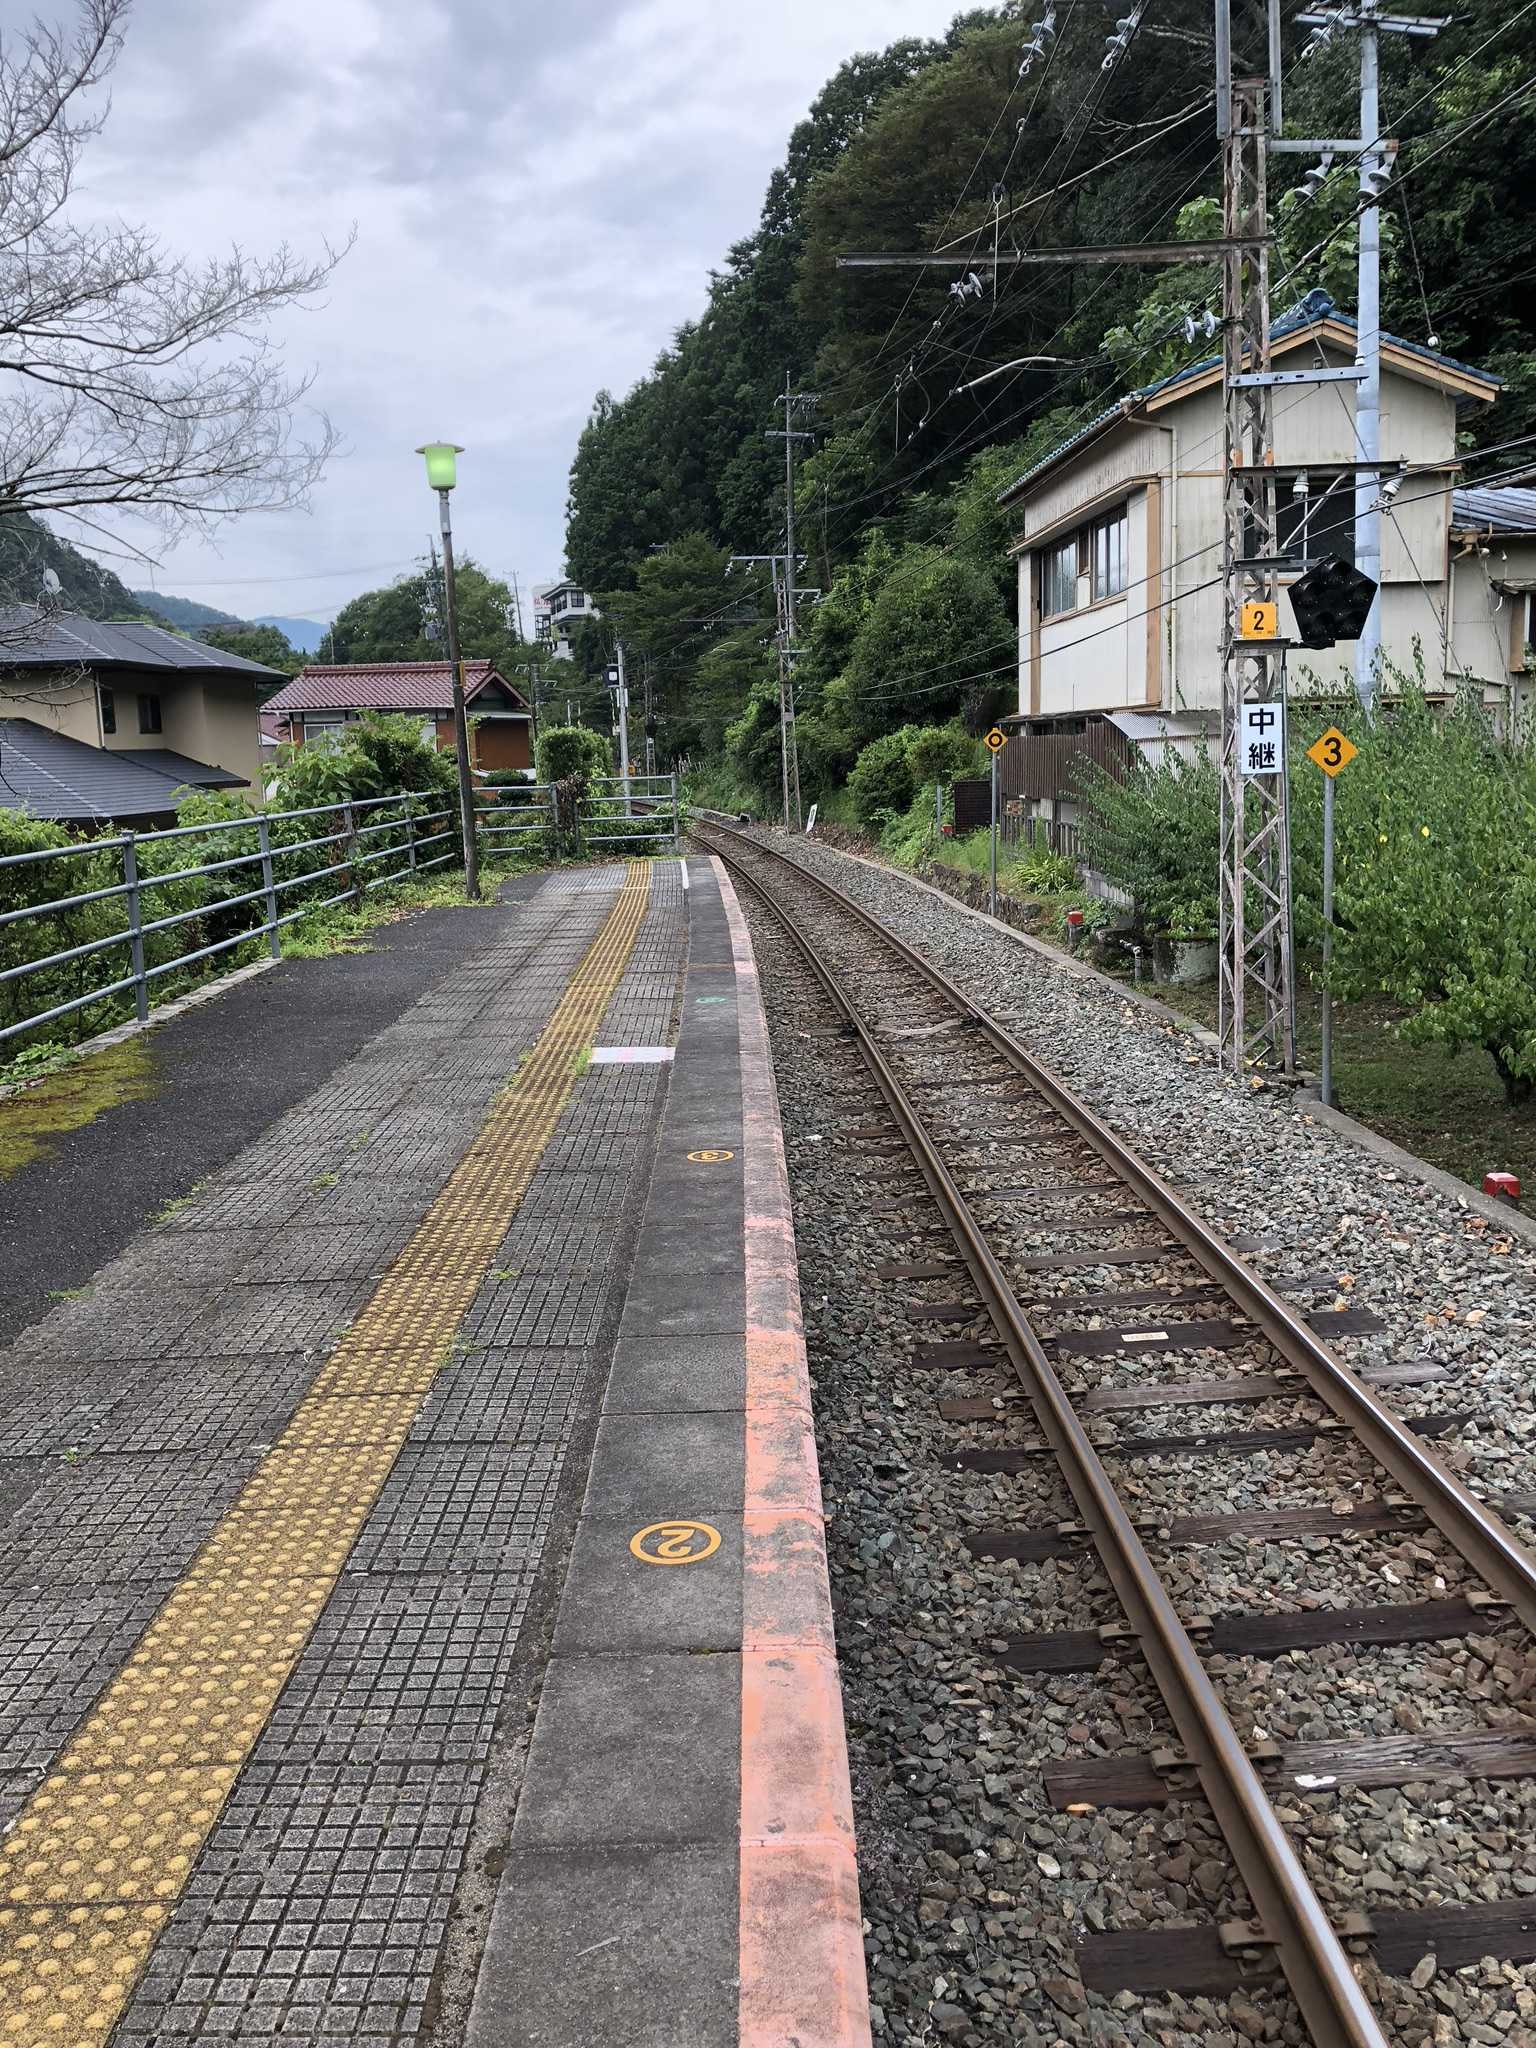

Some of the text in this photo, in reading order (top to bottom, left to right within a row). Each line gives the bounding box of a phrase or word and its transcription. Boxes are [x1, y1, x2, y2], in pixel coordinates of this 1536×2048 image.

[1253, 610, 1264, 631] 2
[1248, 707, 1275, 769] 中継
[1323, 736, 1342, 767] 3
